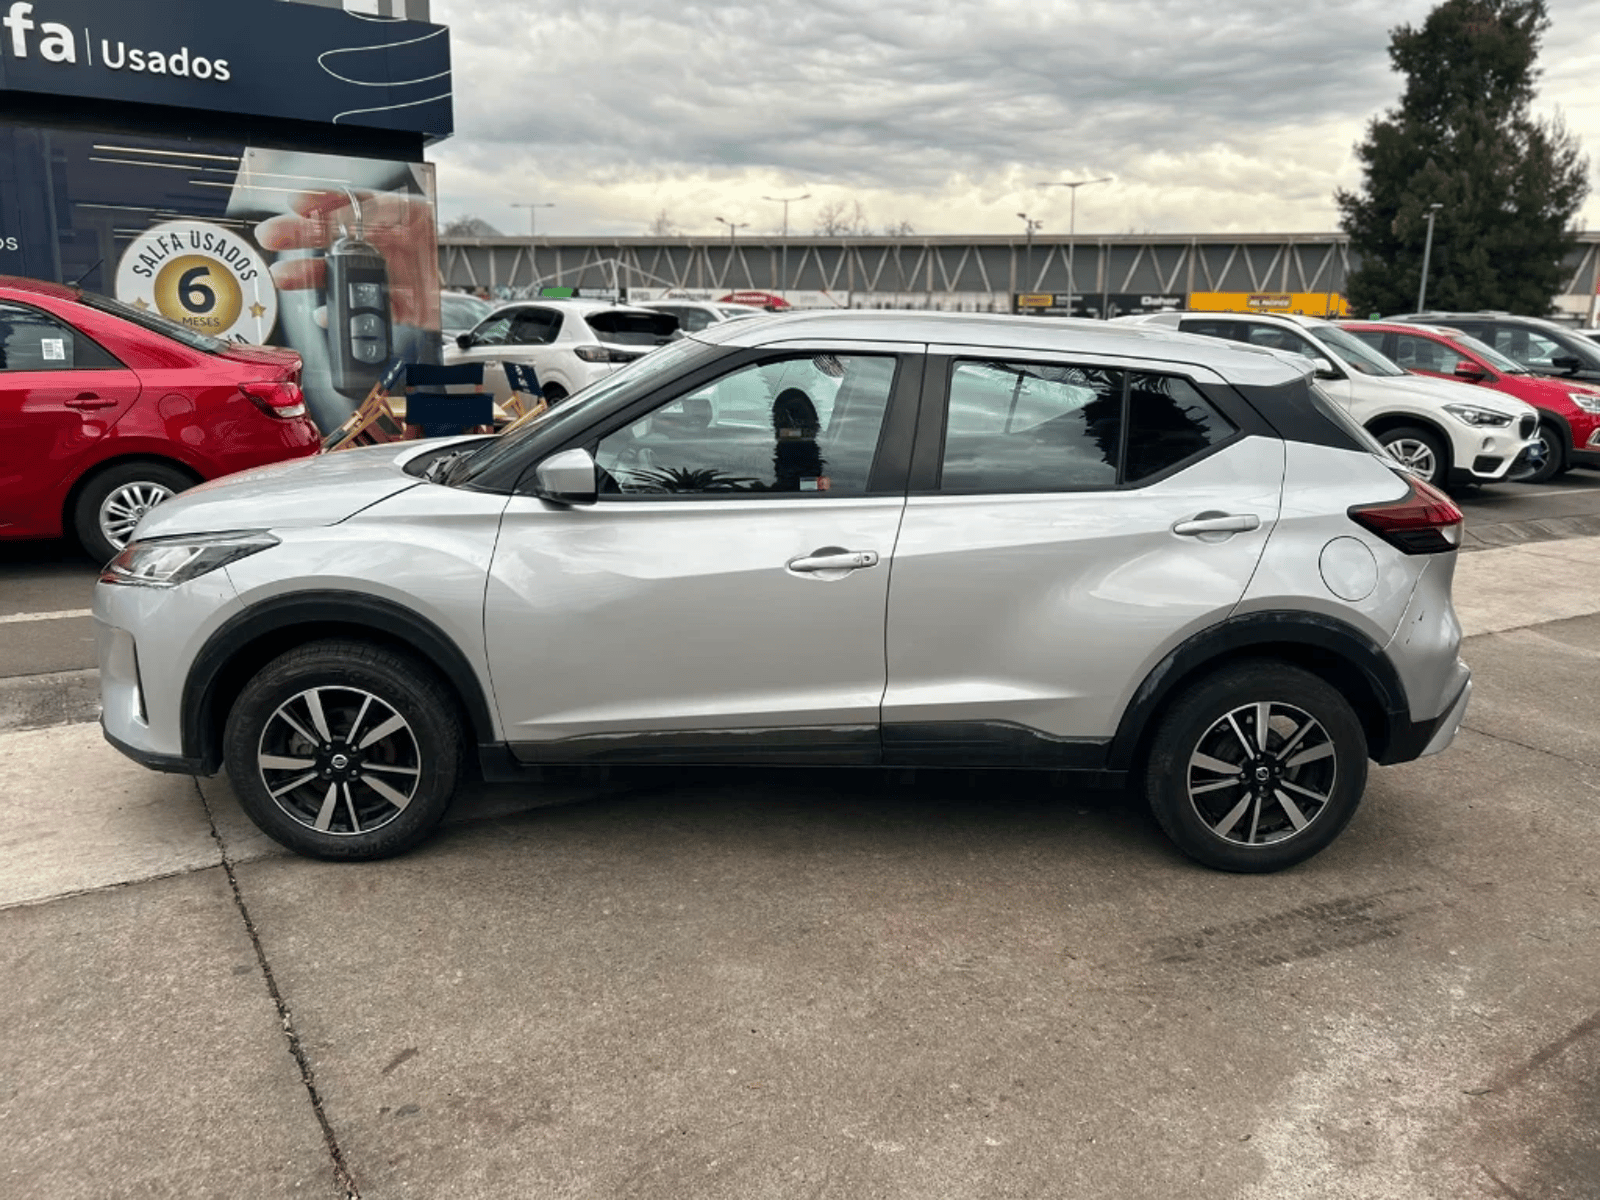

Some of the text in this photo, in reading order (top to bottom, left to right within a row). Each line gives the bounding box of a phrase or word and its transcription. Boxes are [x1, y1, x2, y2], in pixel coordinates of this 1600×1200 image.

[101, 39, 231, 81] Usados
[132, 230, 258, 281] SALFA USADOS
[178, 266, 216, 314] 6
[181, 317, 221, 327] MESES
